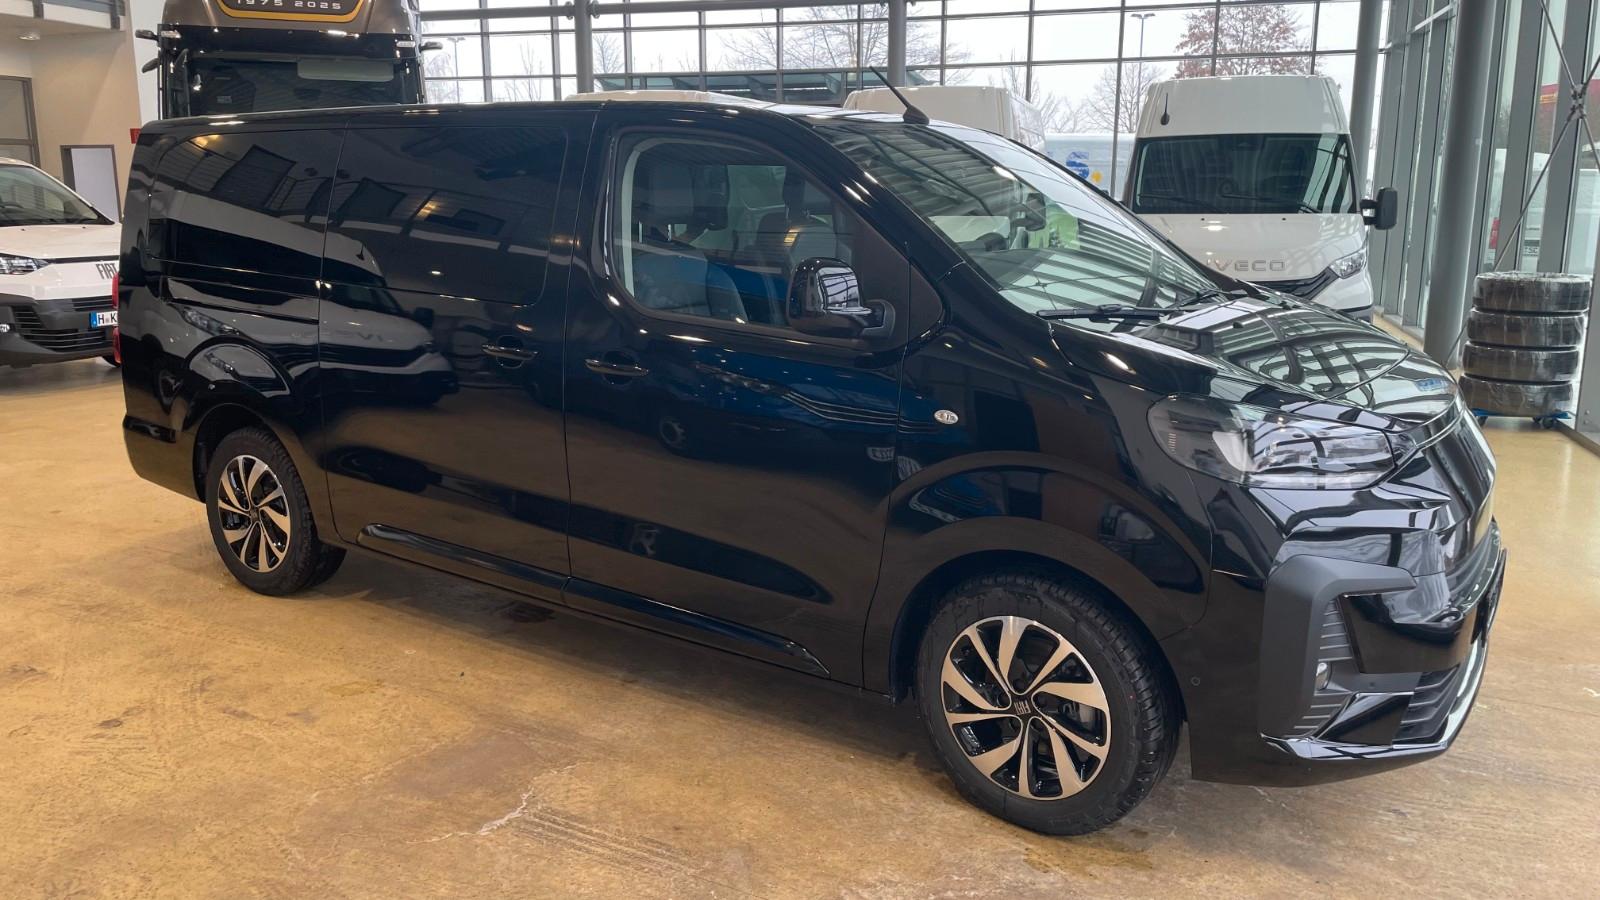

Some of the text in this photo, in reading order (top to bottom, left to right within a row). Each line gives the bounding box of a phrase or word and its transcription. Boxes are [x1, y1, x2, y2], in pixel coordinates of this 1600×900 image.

[294, 1, 341, 10] 2025
[96, 263, 117, 280] FIAT
[1207, 259, 1286, 272] IVECO
[1013, 700, 1031, 716] FIAT
